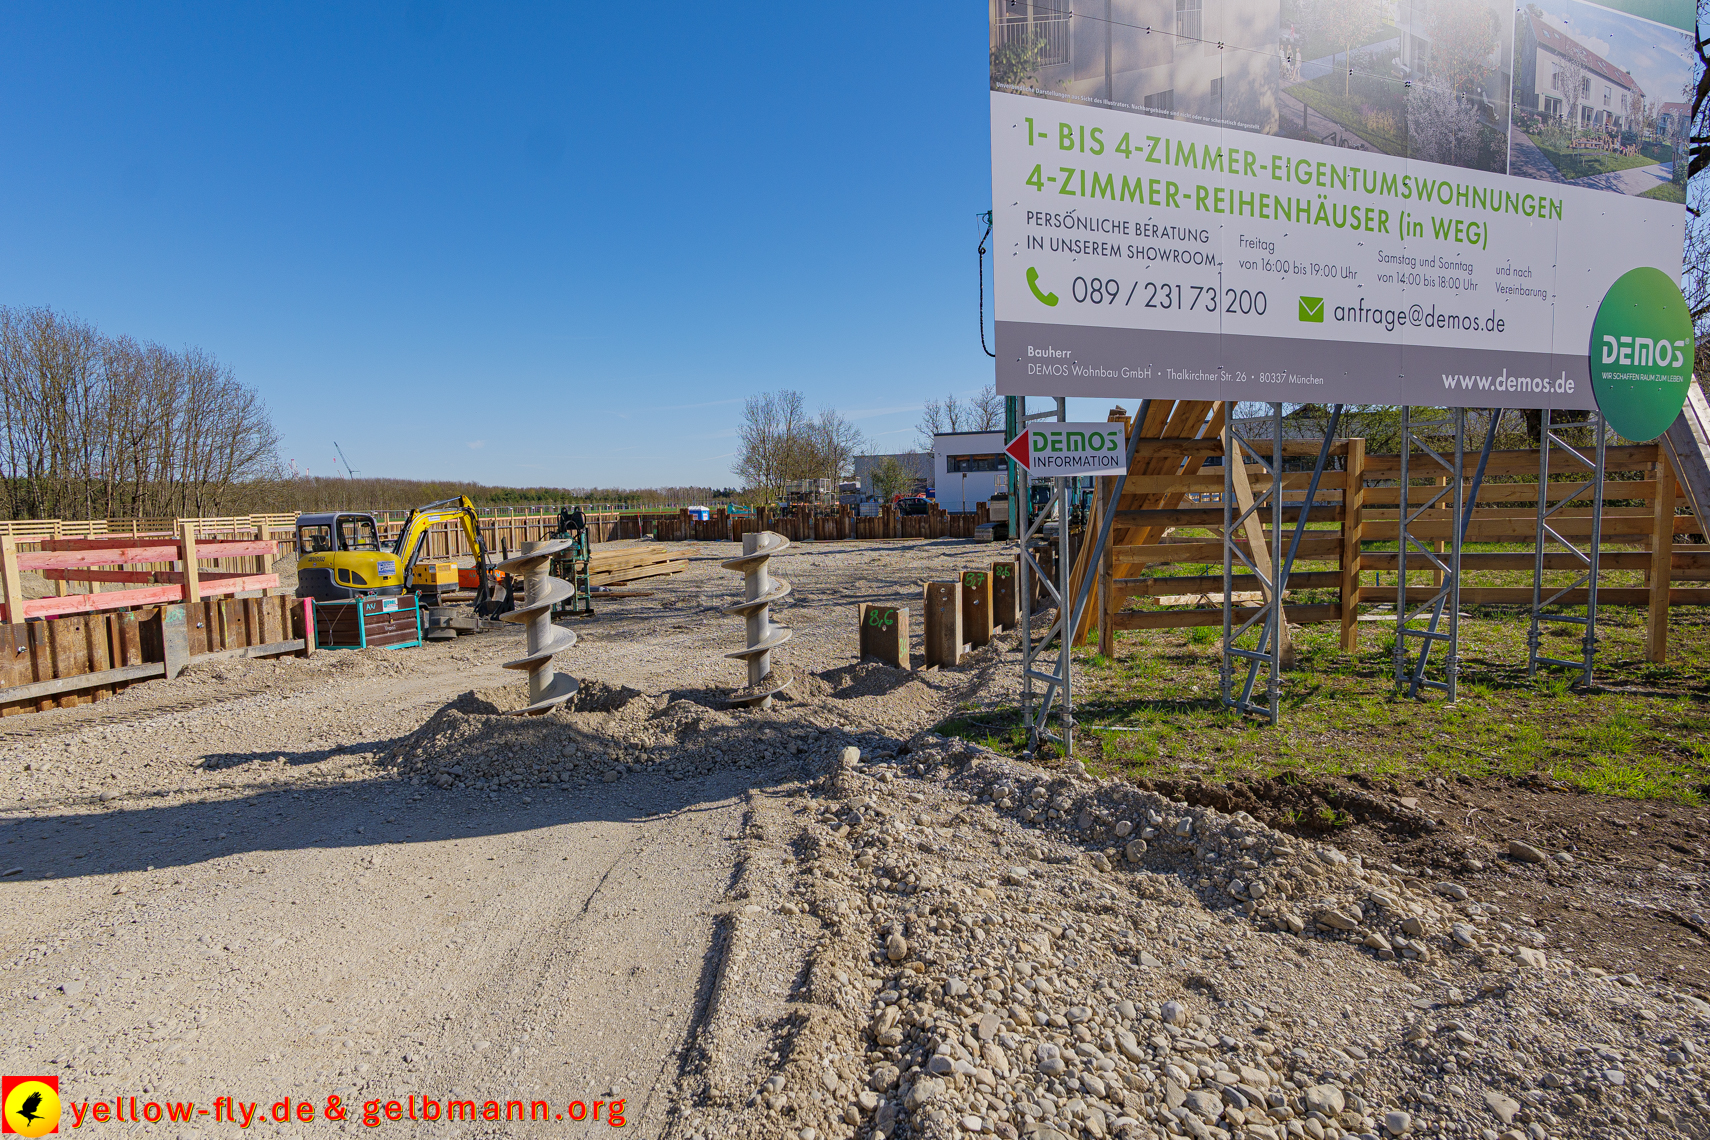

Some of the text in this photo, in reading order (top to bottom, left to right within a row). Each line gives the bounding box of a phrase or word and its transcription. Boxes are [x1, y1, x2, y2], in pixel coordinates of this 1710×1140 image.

[995, 81, 1035, 94] Unverbindliche
[1035, 87, 1071, 100] Darstellungen
[1080, 95, 1094, 103] Sicht
[1093, 96, 1103, 104] des
[1131, 103, 1170, 115] Nachbargebäude
[1170, 109, 1180, 117] sind
[1180, 111, 1192, 119] nicht
[1192, 112, 1203, 120] oder
[1024, 116, 1563, 221] 1- BIS 4-ZIMMER-EIGENTUMSWOHNUNGEN
[1025, 163, 1488, 251] 4-ZIMMER-REIHENHÄUSER (in WEG)
[1026, 210, 1210, 244] PERSÖNLICHE BERATUNG
[1026, 234, 1216, 267] IN UNSEREM SHOWROOM
[1239, 234, 1275, 254] Freitag
[1238, 257, 1358, 281] von 16:00 bis 19:00 Uhr
[1377, 249, 1474, 275] Samstag und Sonntag
[1495, 263, 1533, 279] und nach
[1377, 271, 1479, 292] von 14:00 bis 18:00 Uhr
[1495, 281, 1548, 300] Vereinbarung
[1072, 275, 1267, 315] 089 / 23173 200
[1334, 298, 1506, 332] anfrage@demos.de
[1027, 345, 1072, 359] Bauherr
[1028, 363, 1324, 386] DEMOS Wohnbau GmbH Thalkirchner Str. 26 80337 München
[1442, 368, 1575, 394] www.demos.de
[1601, 371, 1683, 383] WIR SCHAFFEN RAUM ZUM LEBEN
[1033, 455, 1119, 468] INFORMATION
